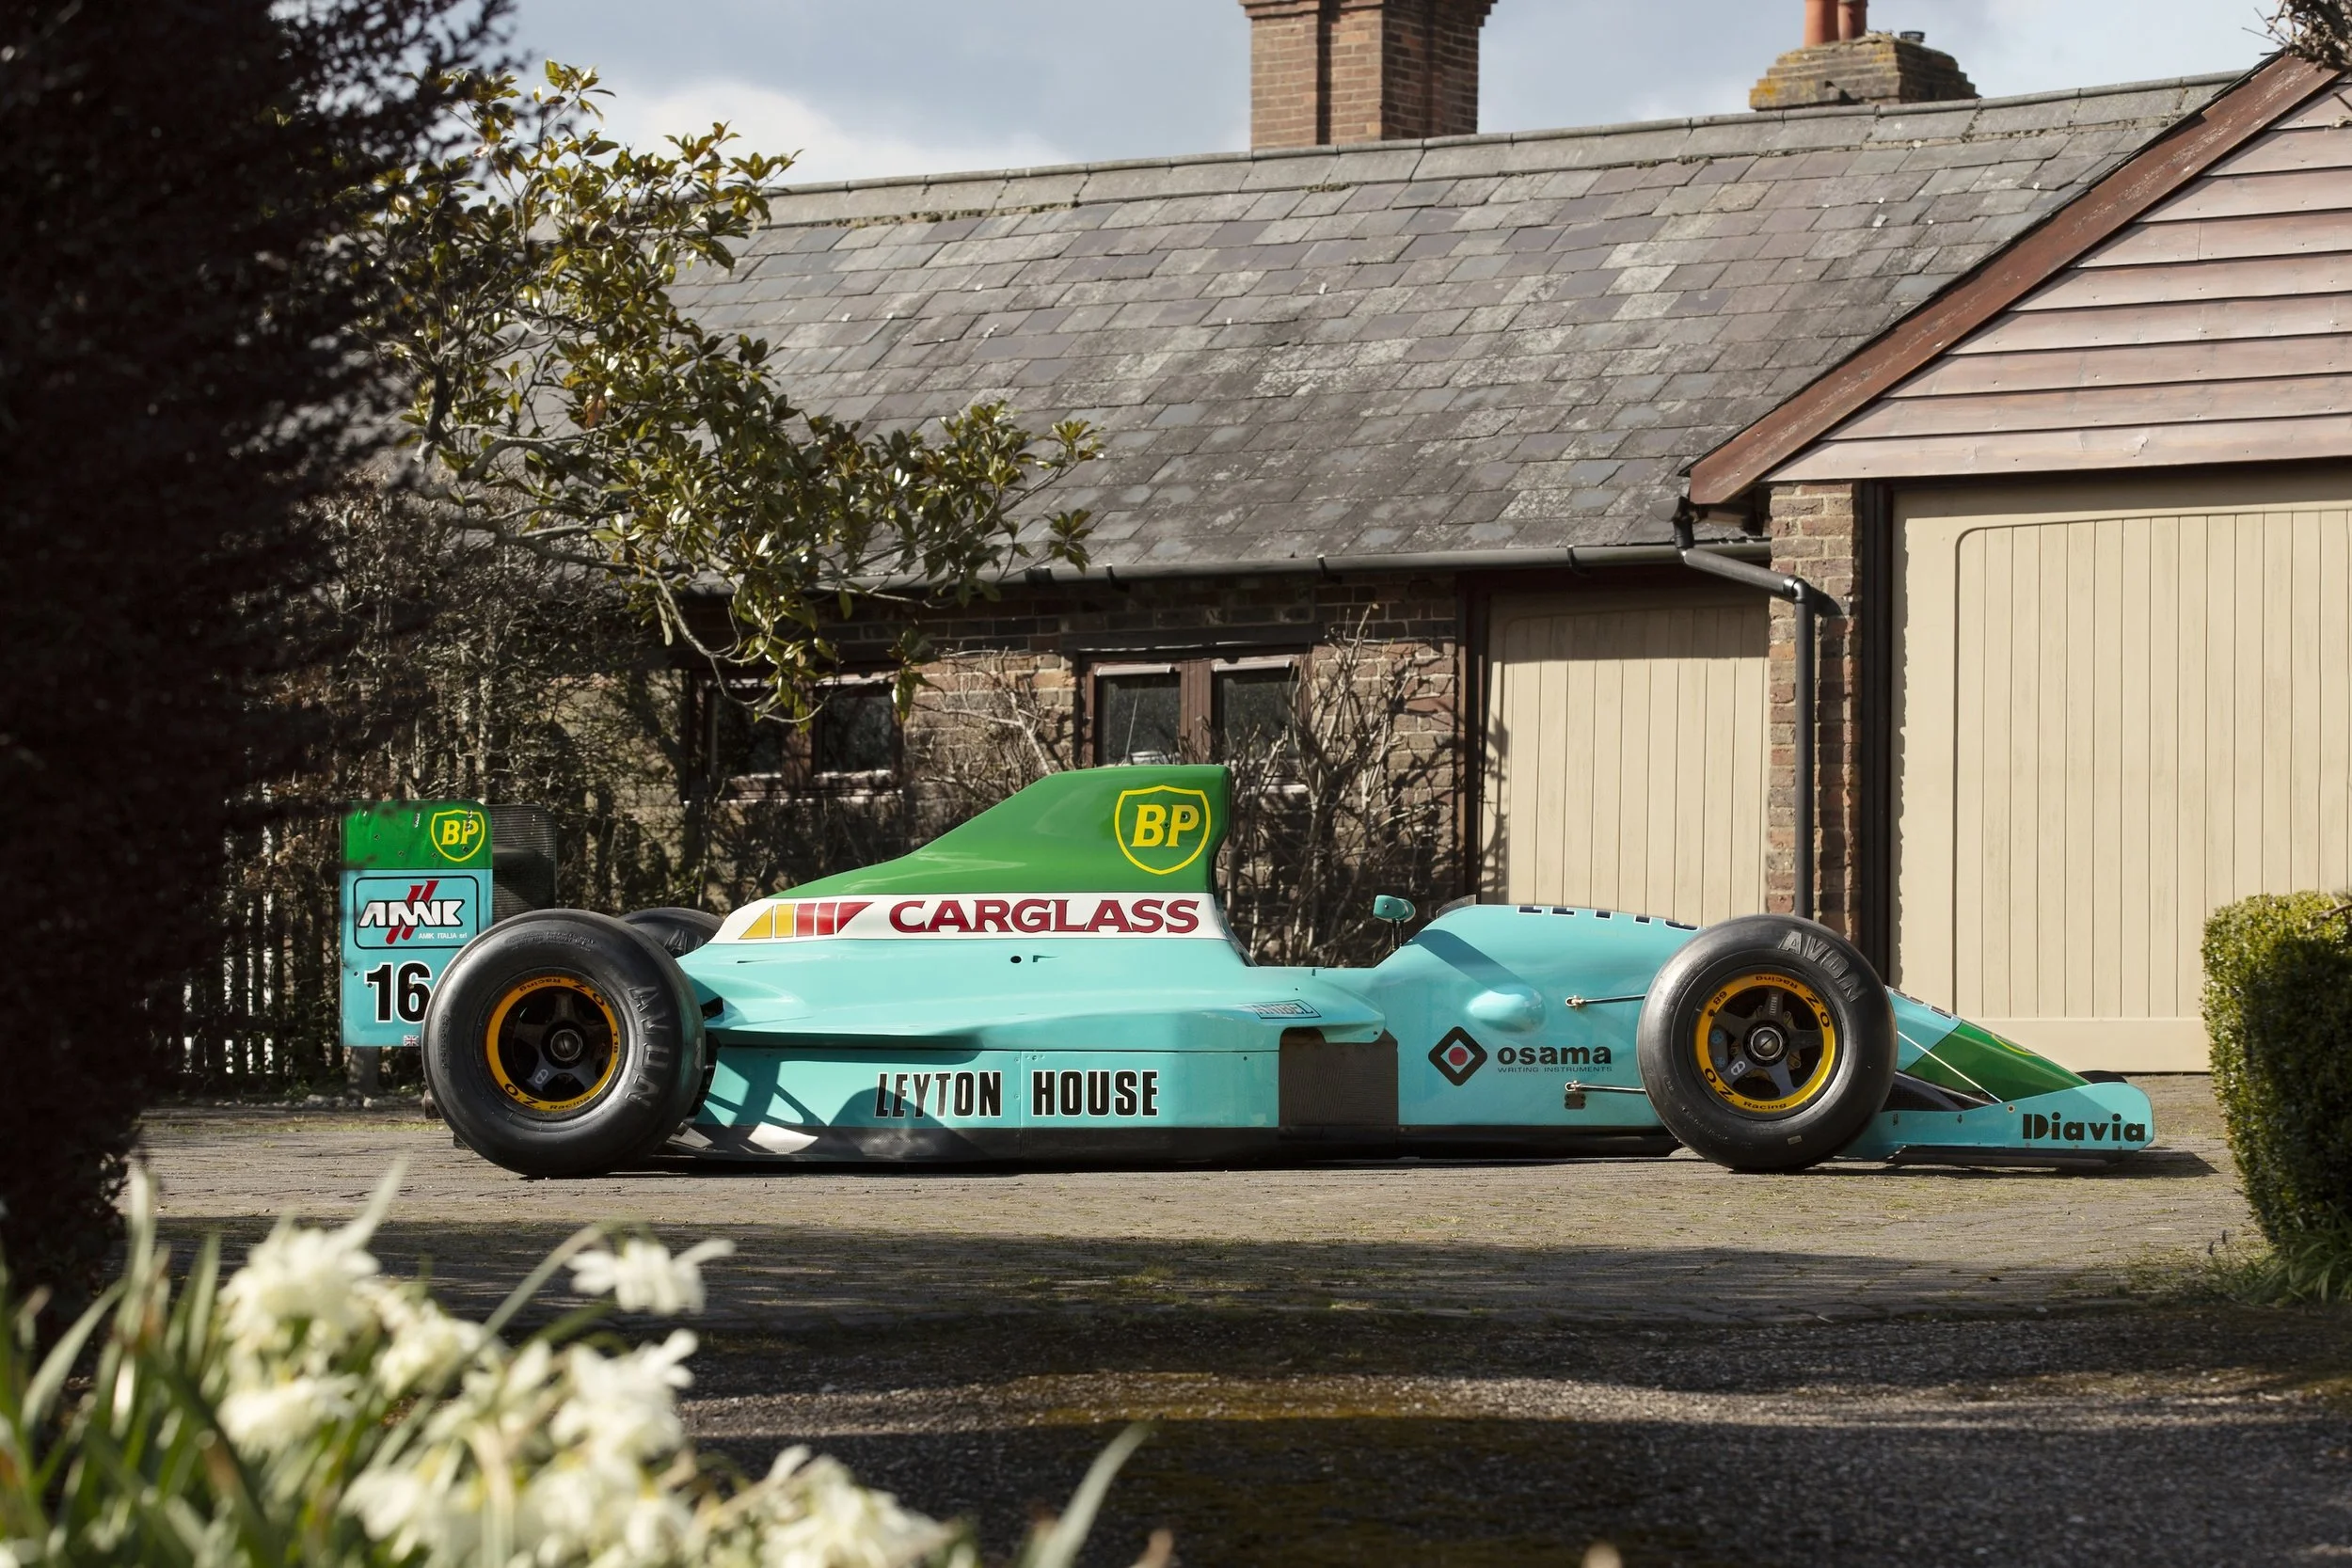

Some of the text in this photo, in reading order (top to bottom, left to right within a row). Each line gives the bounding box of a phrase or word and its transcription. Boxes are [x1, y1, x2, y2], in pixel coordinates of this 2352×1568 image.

[441, 819, 479, 846] BP
[1131, 804, 1200, 847] BP
[889, 898, 1200, 934] CARGLASS
[1778, 930, 1868, 1003] AVON
[364, 961, 433, 1024] 16
[1755, 975, 1798, 990] Racing
[1497, 1046, 1612, 1065] osama
[549, 1096, 591, 1110] Racing
[875, 1069, 1159, 1119] LEYTON HOUSE
[1743, 1101, 1788, 1110] Racing
[2023, 1112, 2146, 1142] Diavia
